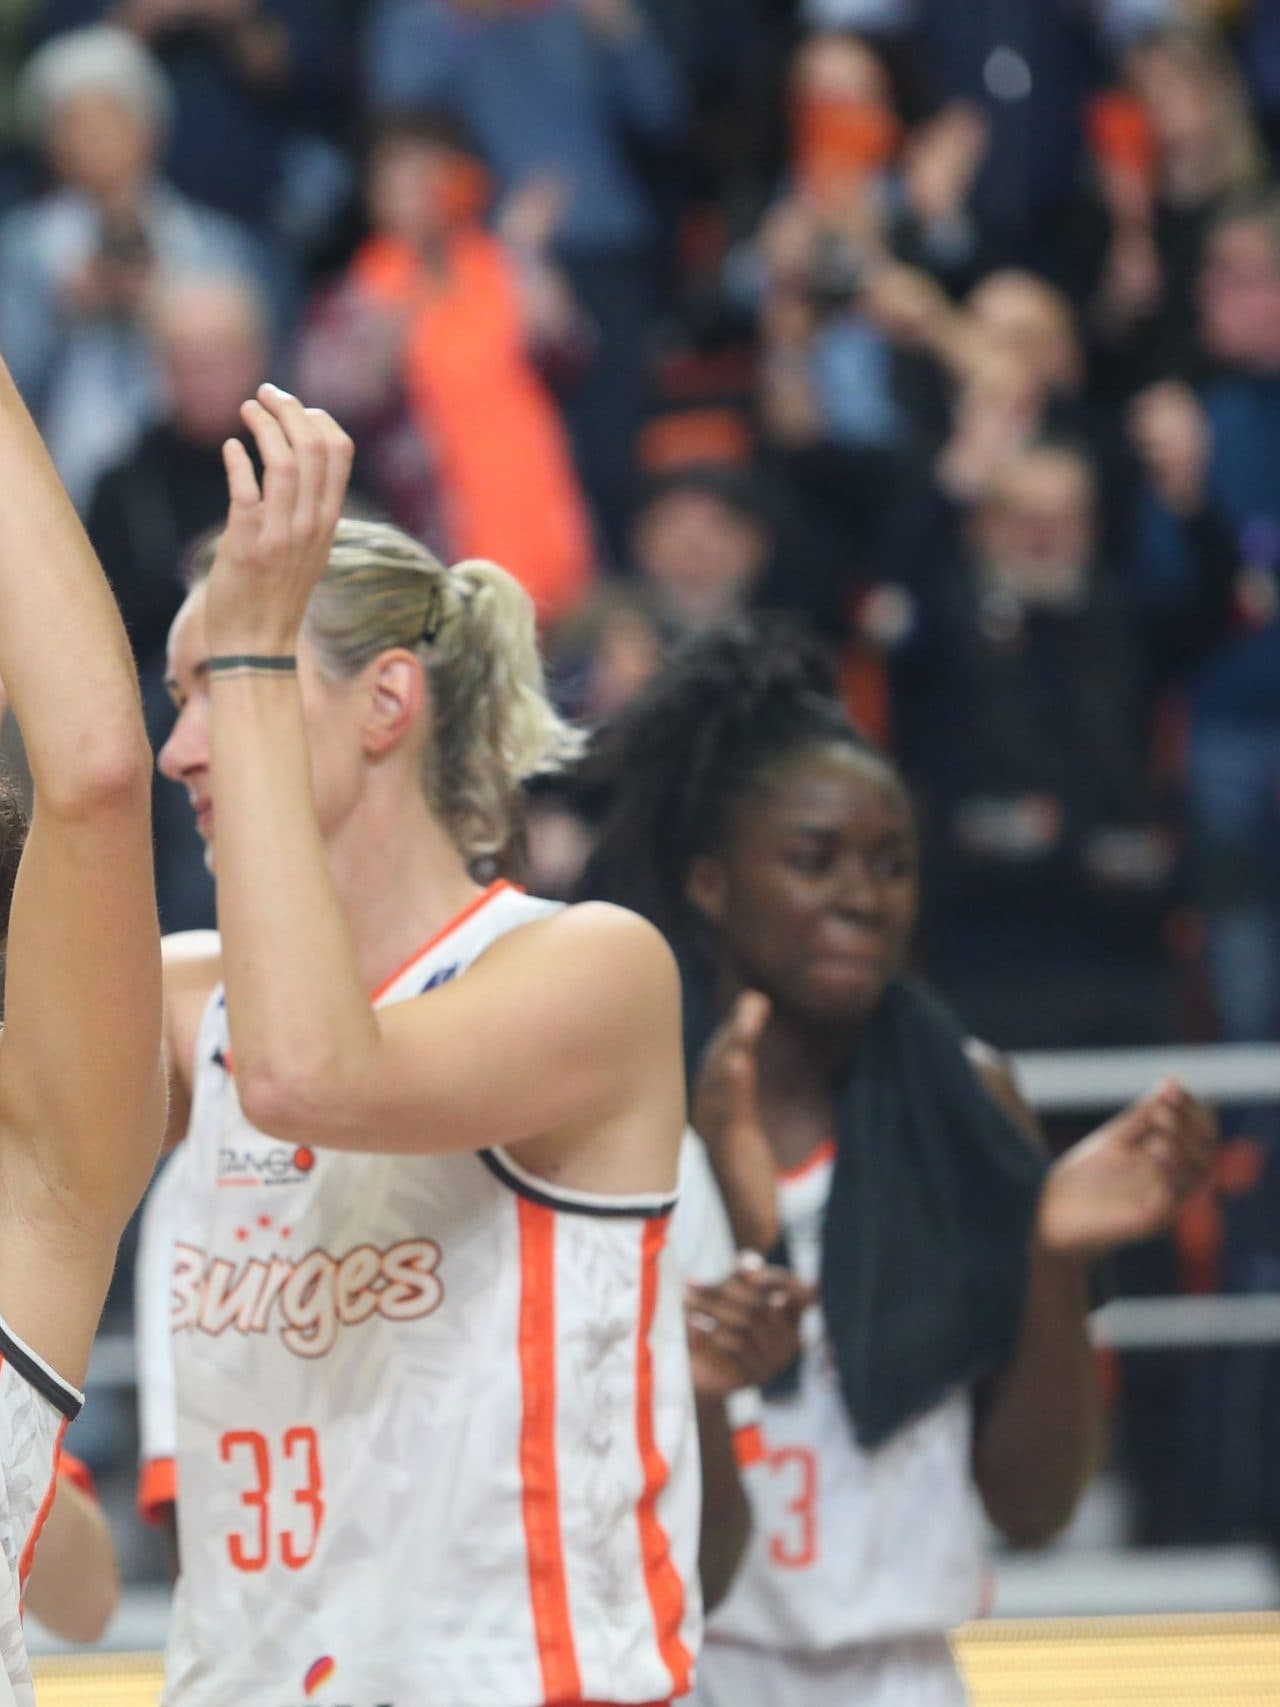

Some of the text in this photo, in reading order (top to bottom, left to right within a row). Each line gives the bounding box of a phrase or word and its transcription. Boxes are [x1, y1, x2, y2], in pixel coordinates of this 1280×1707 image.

[171, 1239, 445, 1360] Burges
[220, 1426, 325, 1573] 33
[767, 1446, 819, 1570] 3
